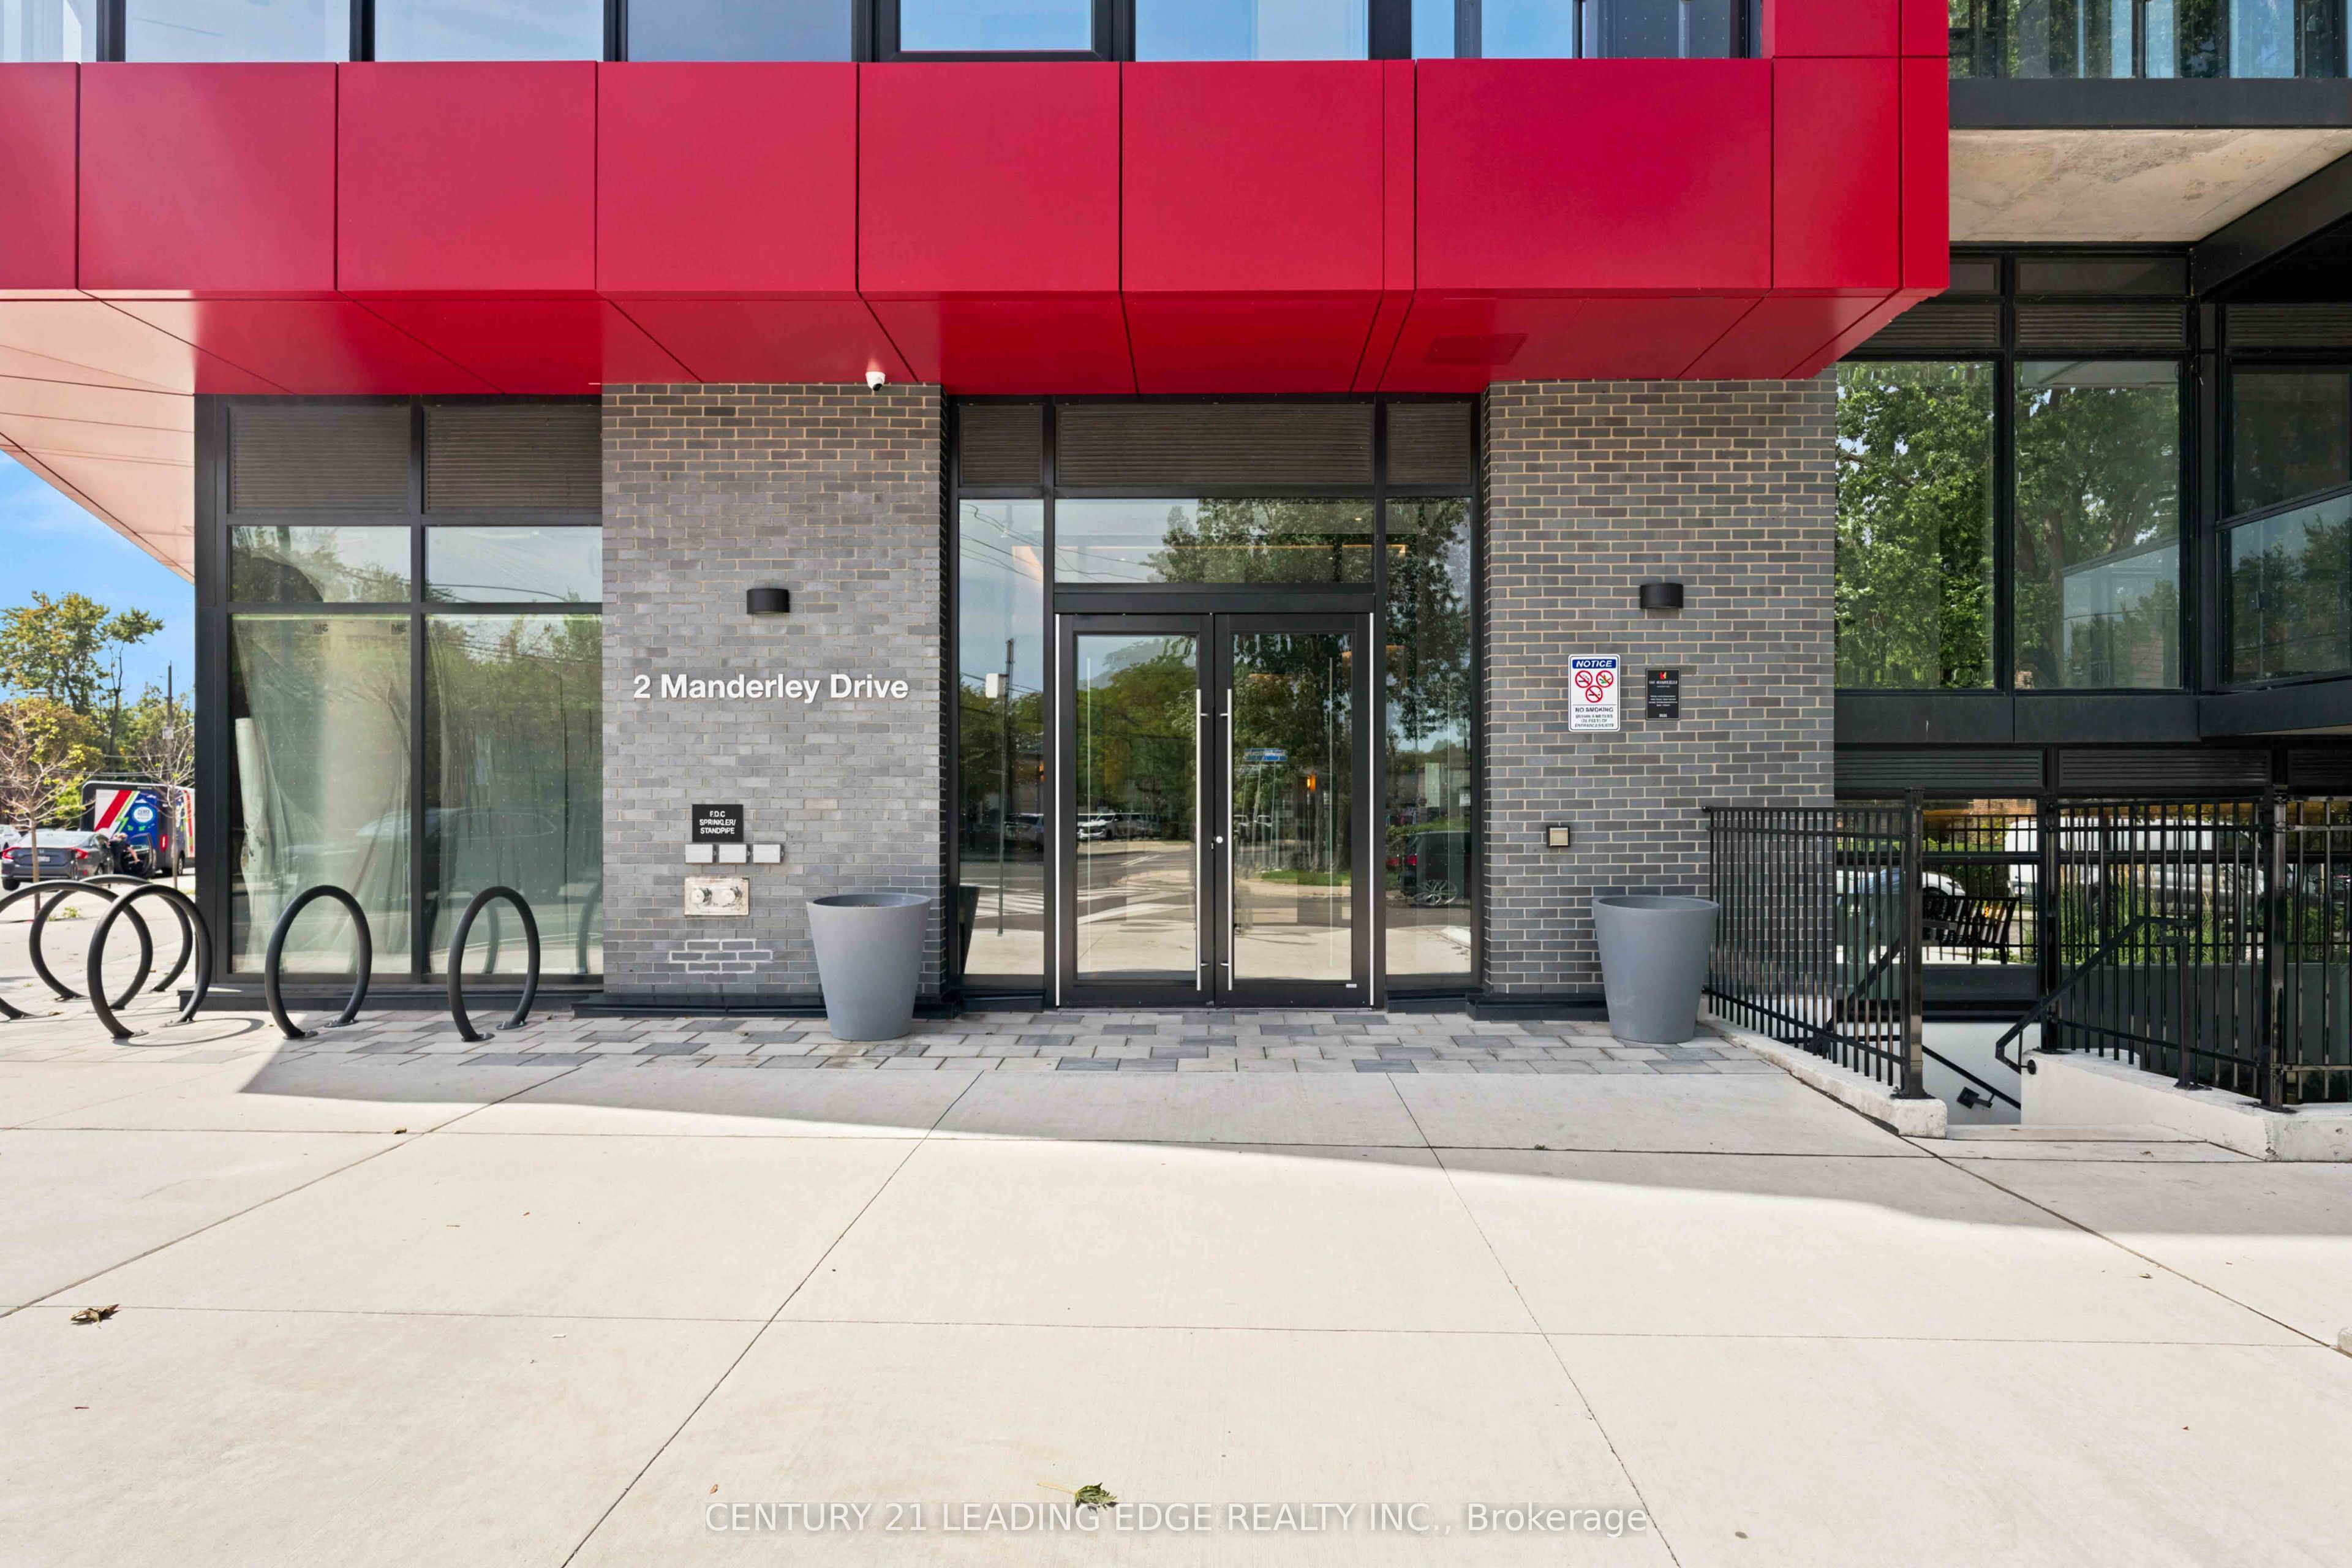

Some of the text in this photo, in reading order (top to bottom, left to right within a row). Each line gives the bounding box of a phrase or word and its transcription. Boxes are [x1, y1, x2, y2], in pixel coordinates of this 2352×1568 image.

[633, 674, 909, 704] 2 Manderley Drive
